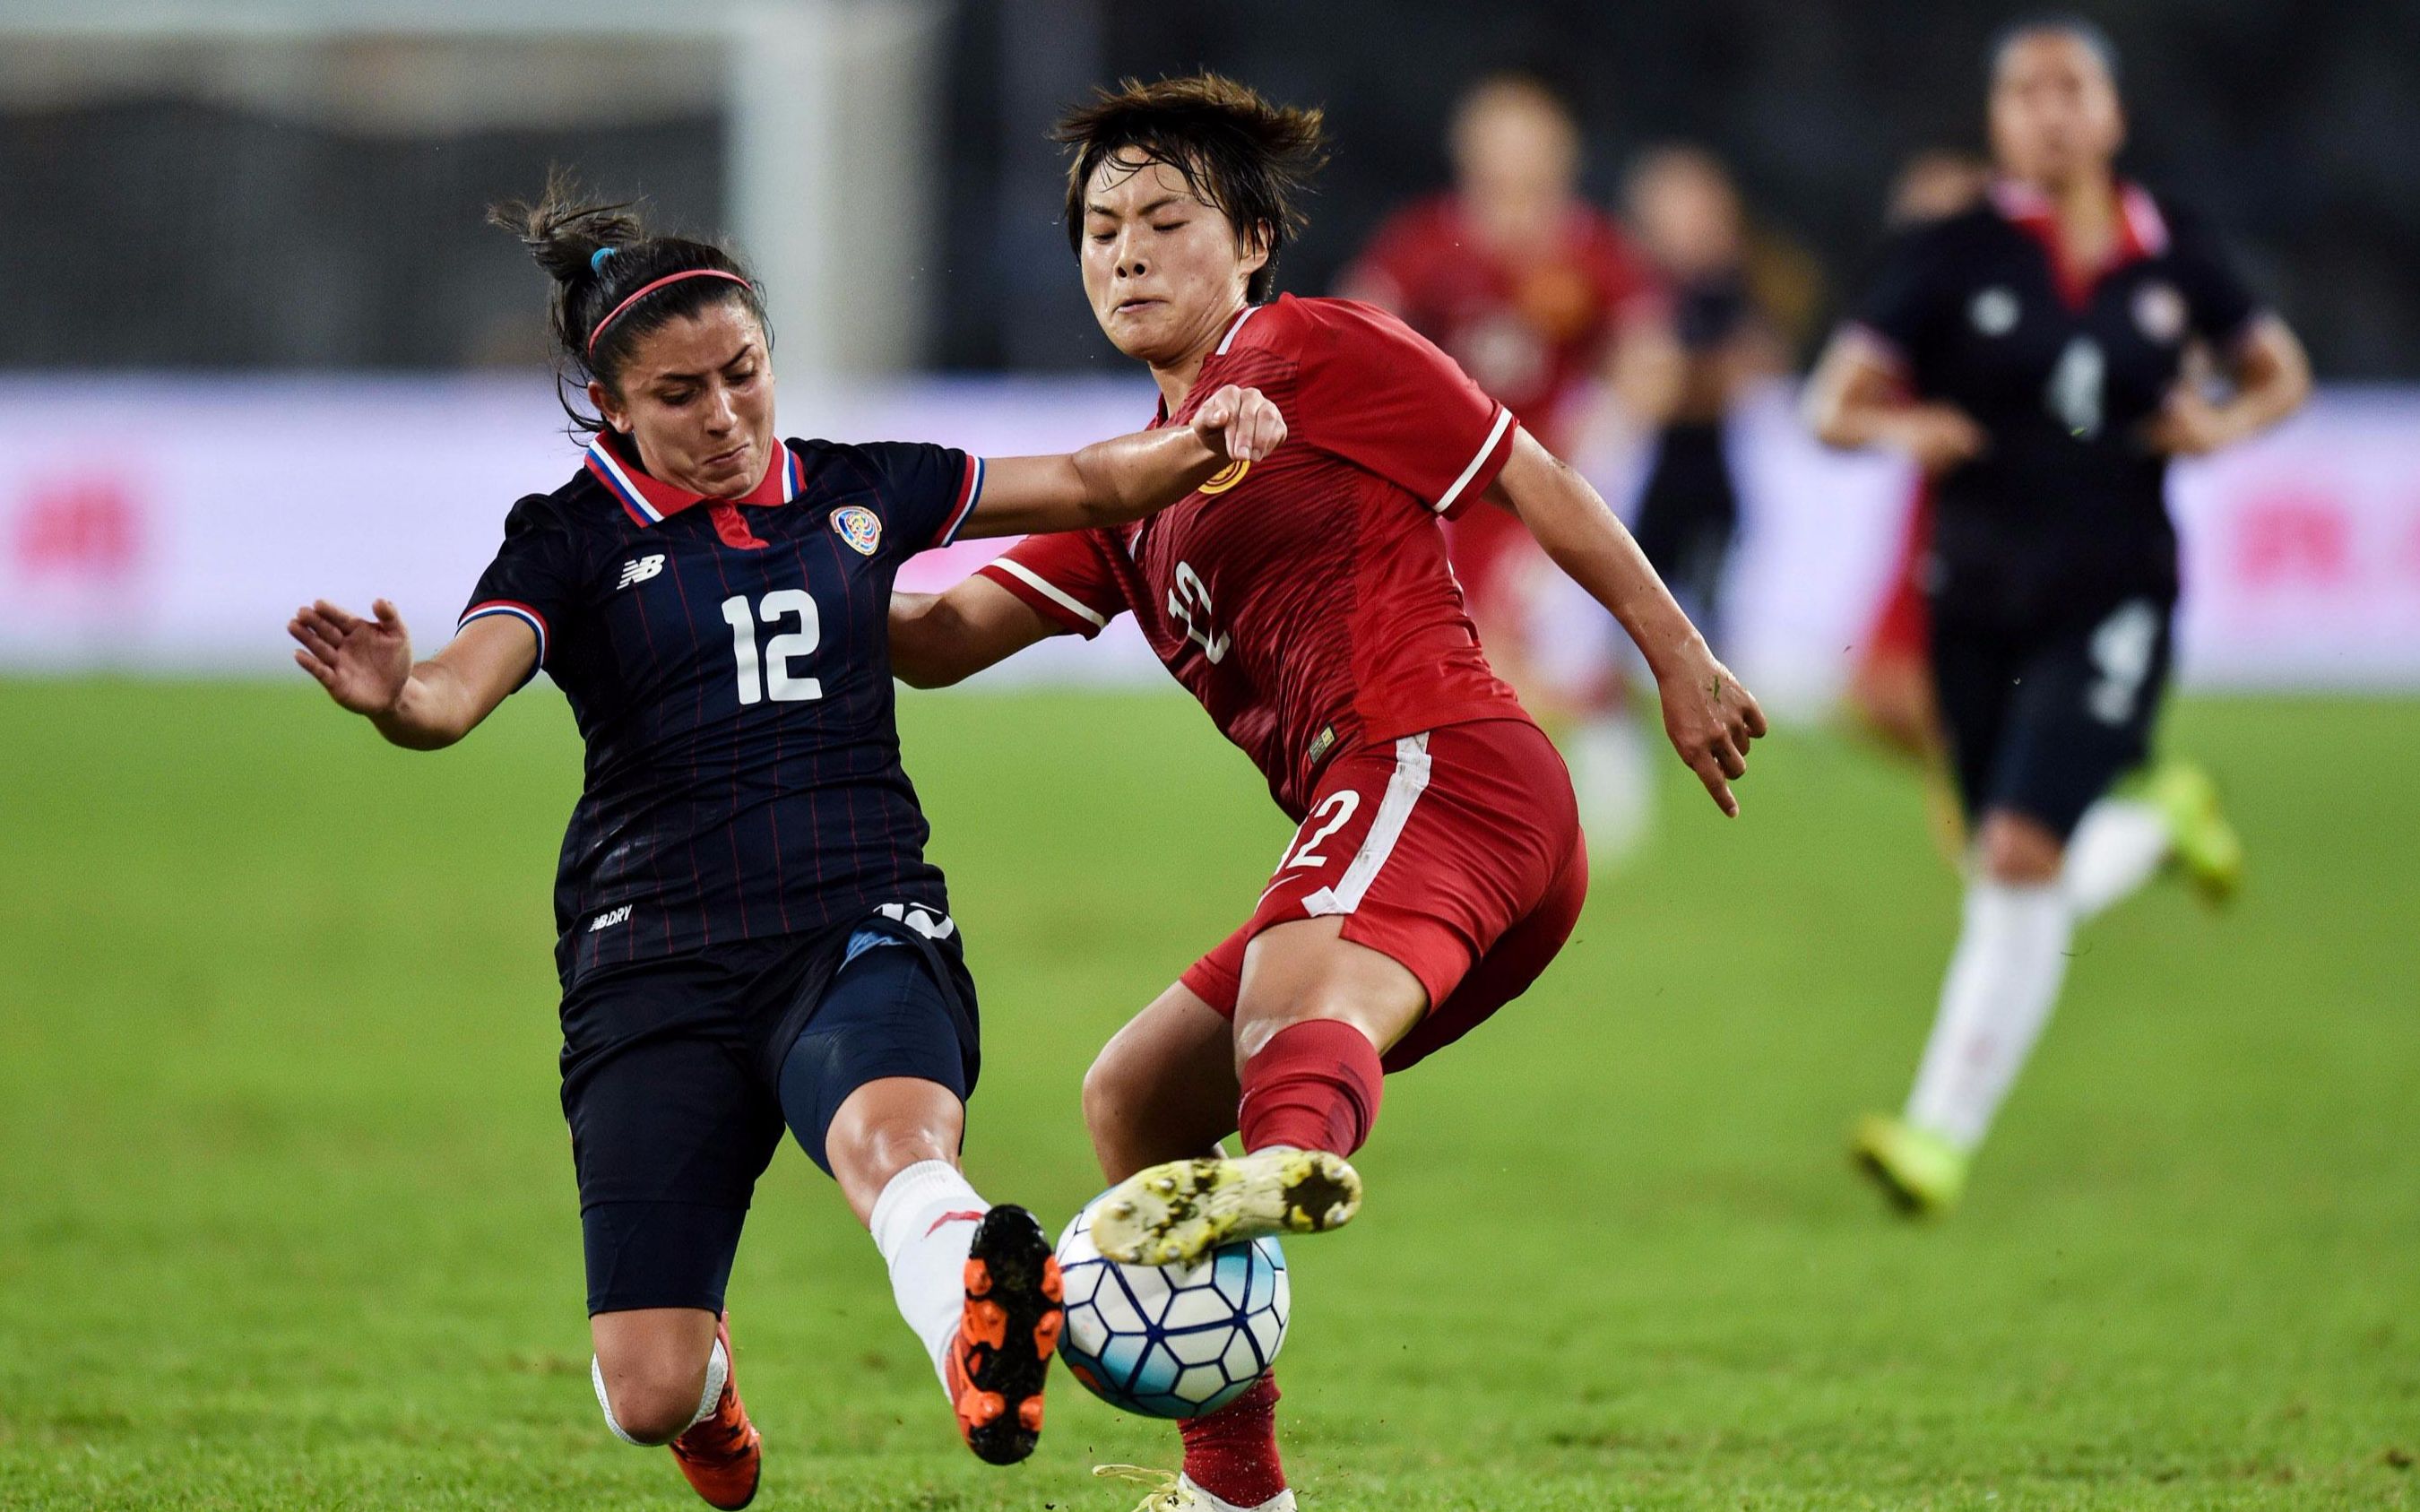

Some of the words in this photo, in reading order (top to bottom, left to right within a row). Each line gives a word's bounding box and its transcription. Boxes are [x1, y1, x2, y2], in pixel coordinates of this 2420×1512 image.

[616, 554, 666, 591] NB
[1168, 560, 1232, 665] 12
[722, 589, 823, 704] 12
[1274, 790, 1361, 875] 2
